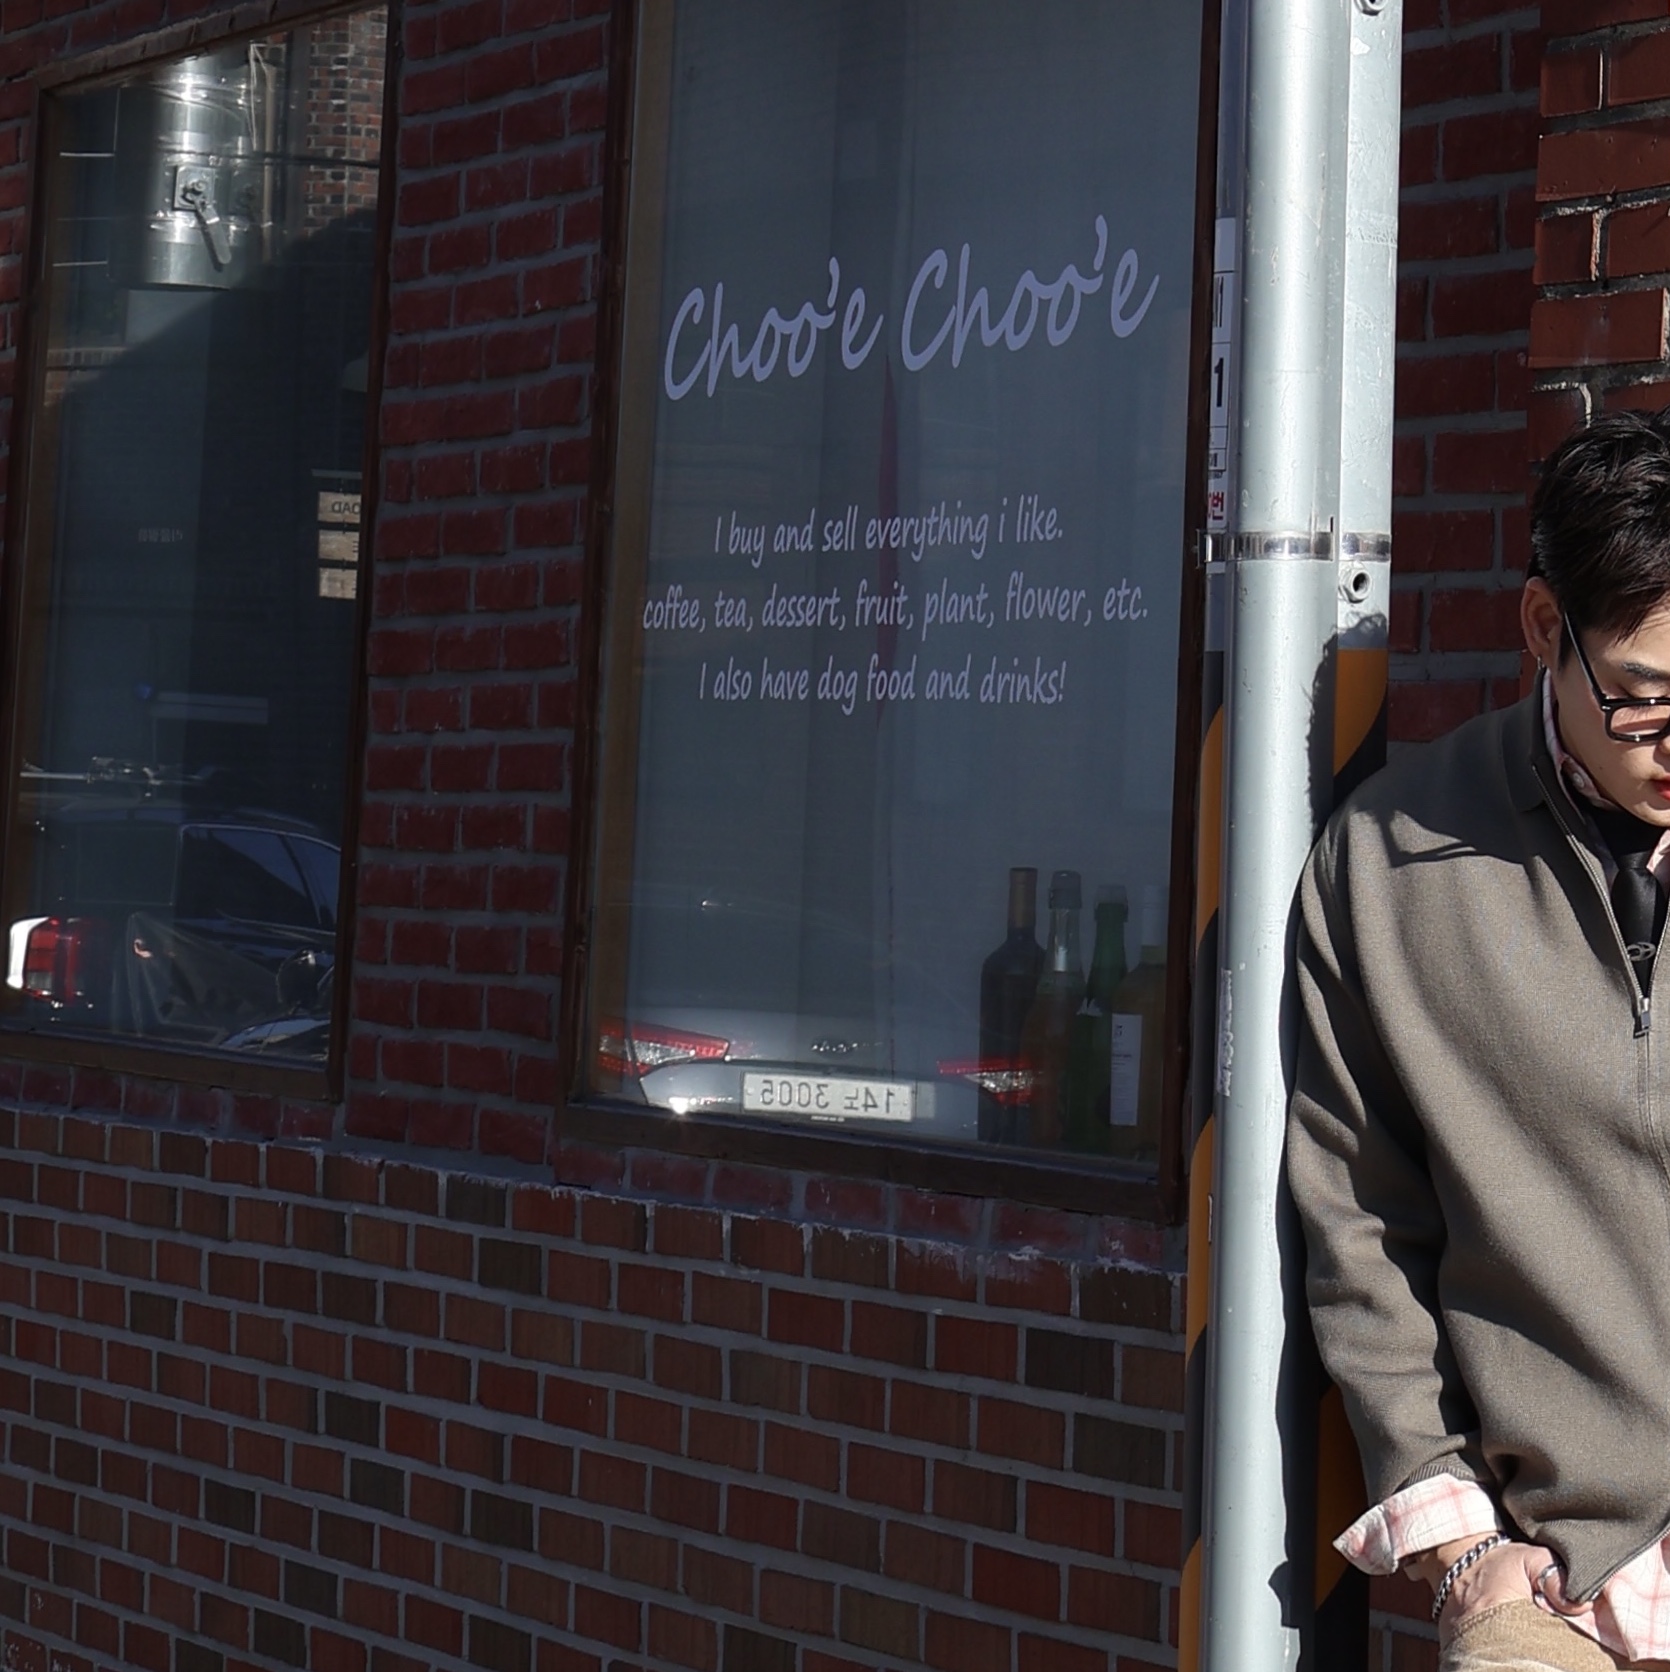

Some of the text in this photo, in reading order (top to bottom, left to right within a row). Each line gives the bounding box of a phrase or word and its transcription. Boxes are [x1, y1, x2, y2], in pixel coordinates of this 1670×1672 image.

[664, 214, 1160, 401] Choo'e Choo'e
[714, 494, 1063, 569] I buy and sell everything i like.
[642, 570, 1148, 642] coffee, tea, dessert, fruit, plant, flower, etc.
[699, 652, 1067, 716] I also have dog food and drinks!
